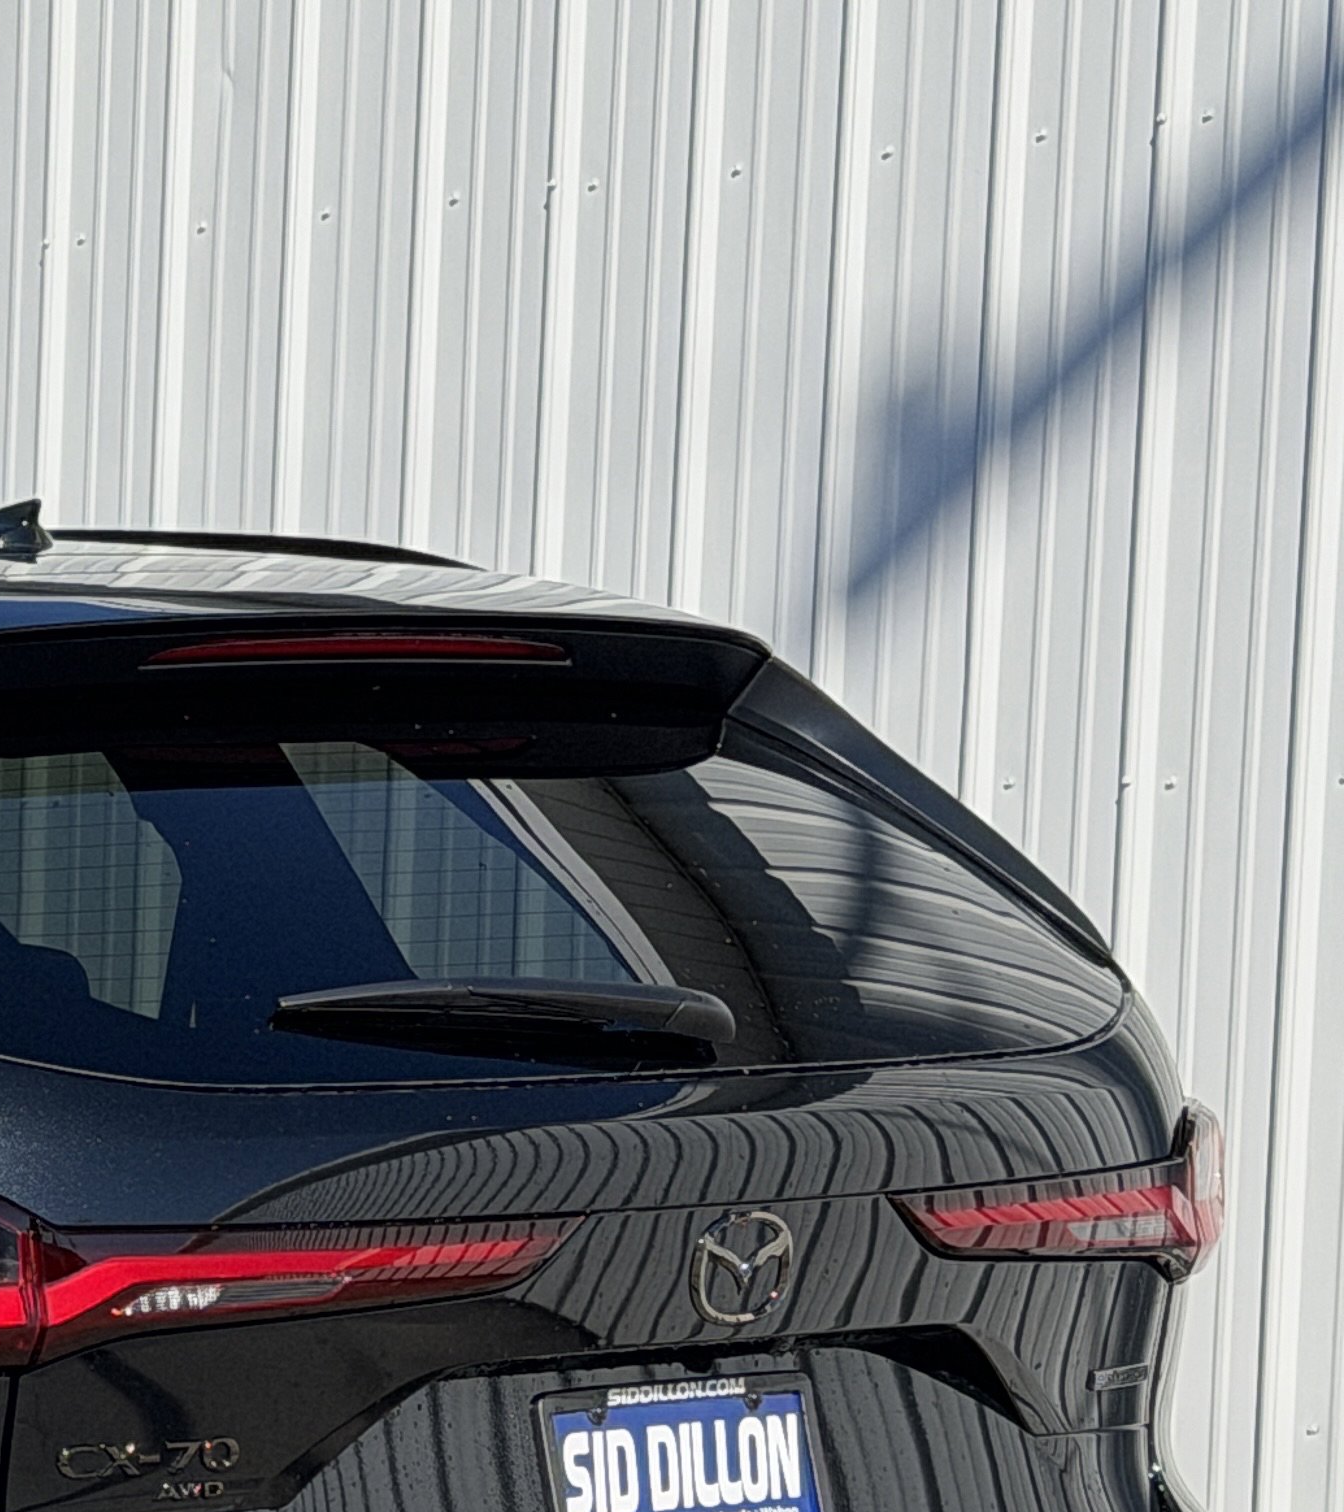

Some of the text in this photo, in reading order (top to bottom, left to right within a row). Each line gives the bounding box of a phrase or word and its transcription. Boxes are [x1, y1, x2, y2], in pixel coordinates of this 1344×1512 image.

[607, 1377, 746, 1406] SIDDILLON.COM
[56, 1436, 240, 1479] CX-70
[646, 1413, 801, 1512] DILLON
[156, 1481, 224, 1501] AWD
